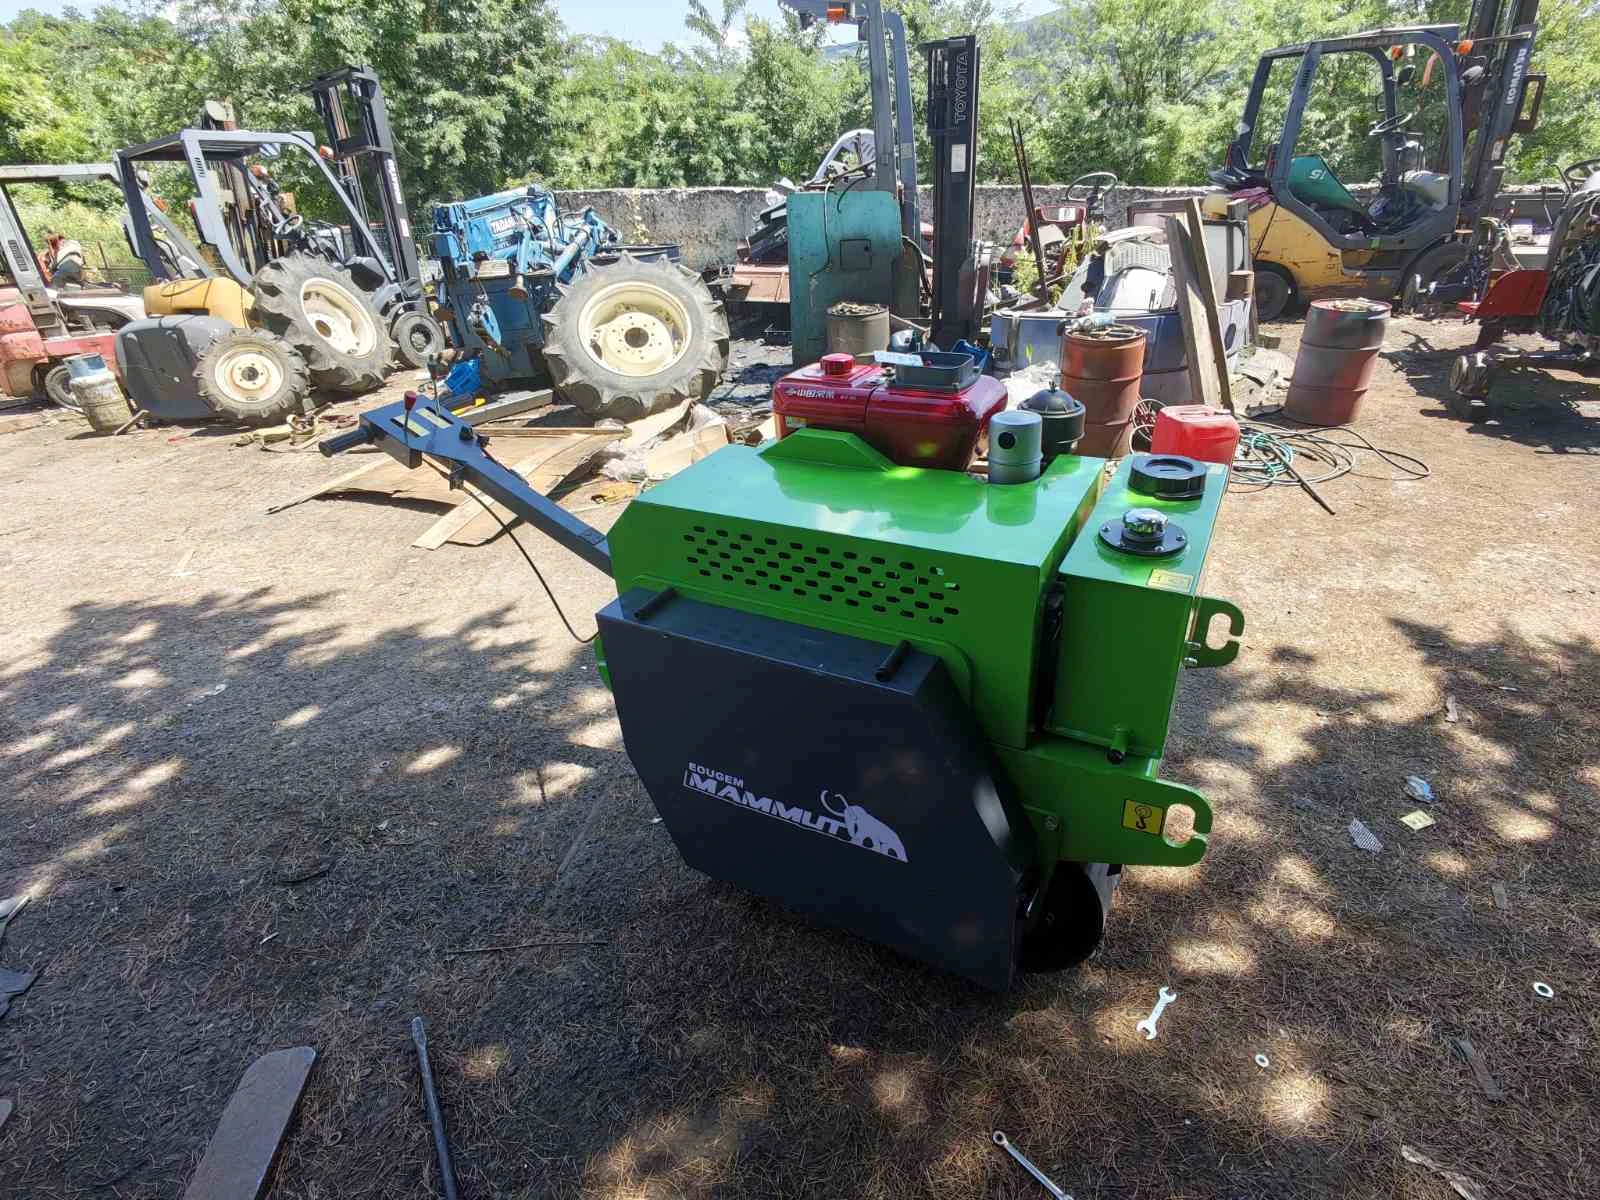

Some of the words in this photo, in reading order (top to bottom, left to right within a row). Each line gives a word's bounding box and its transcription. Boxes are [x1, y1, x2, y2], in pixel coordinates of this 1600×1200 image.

[955, 51, 968, 125] TOYOTA
[1505, 48, 1527, 104] KOMATSU
[689, 772, 847, 835] MAMMUT
